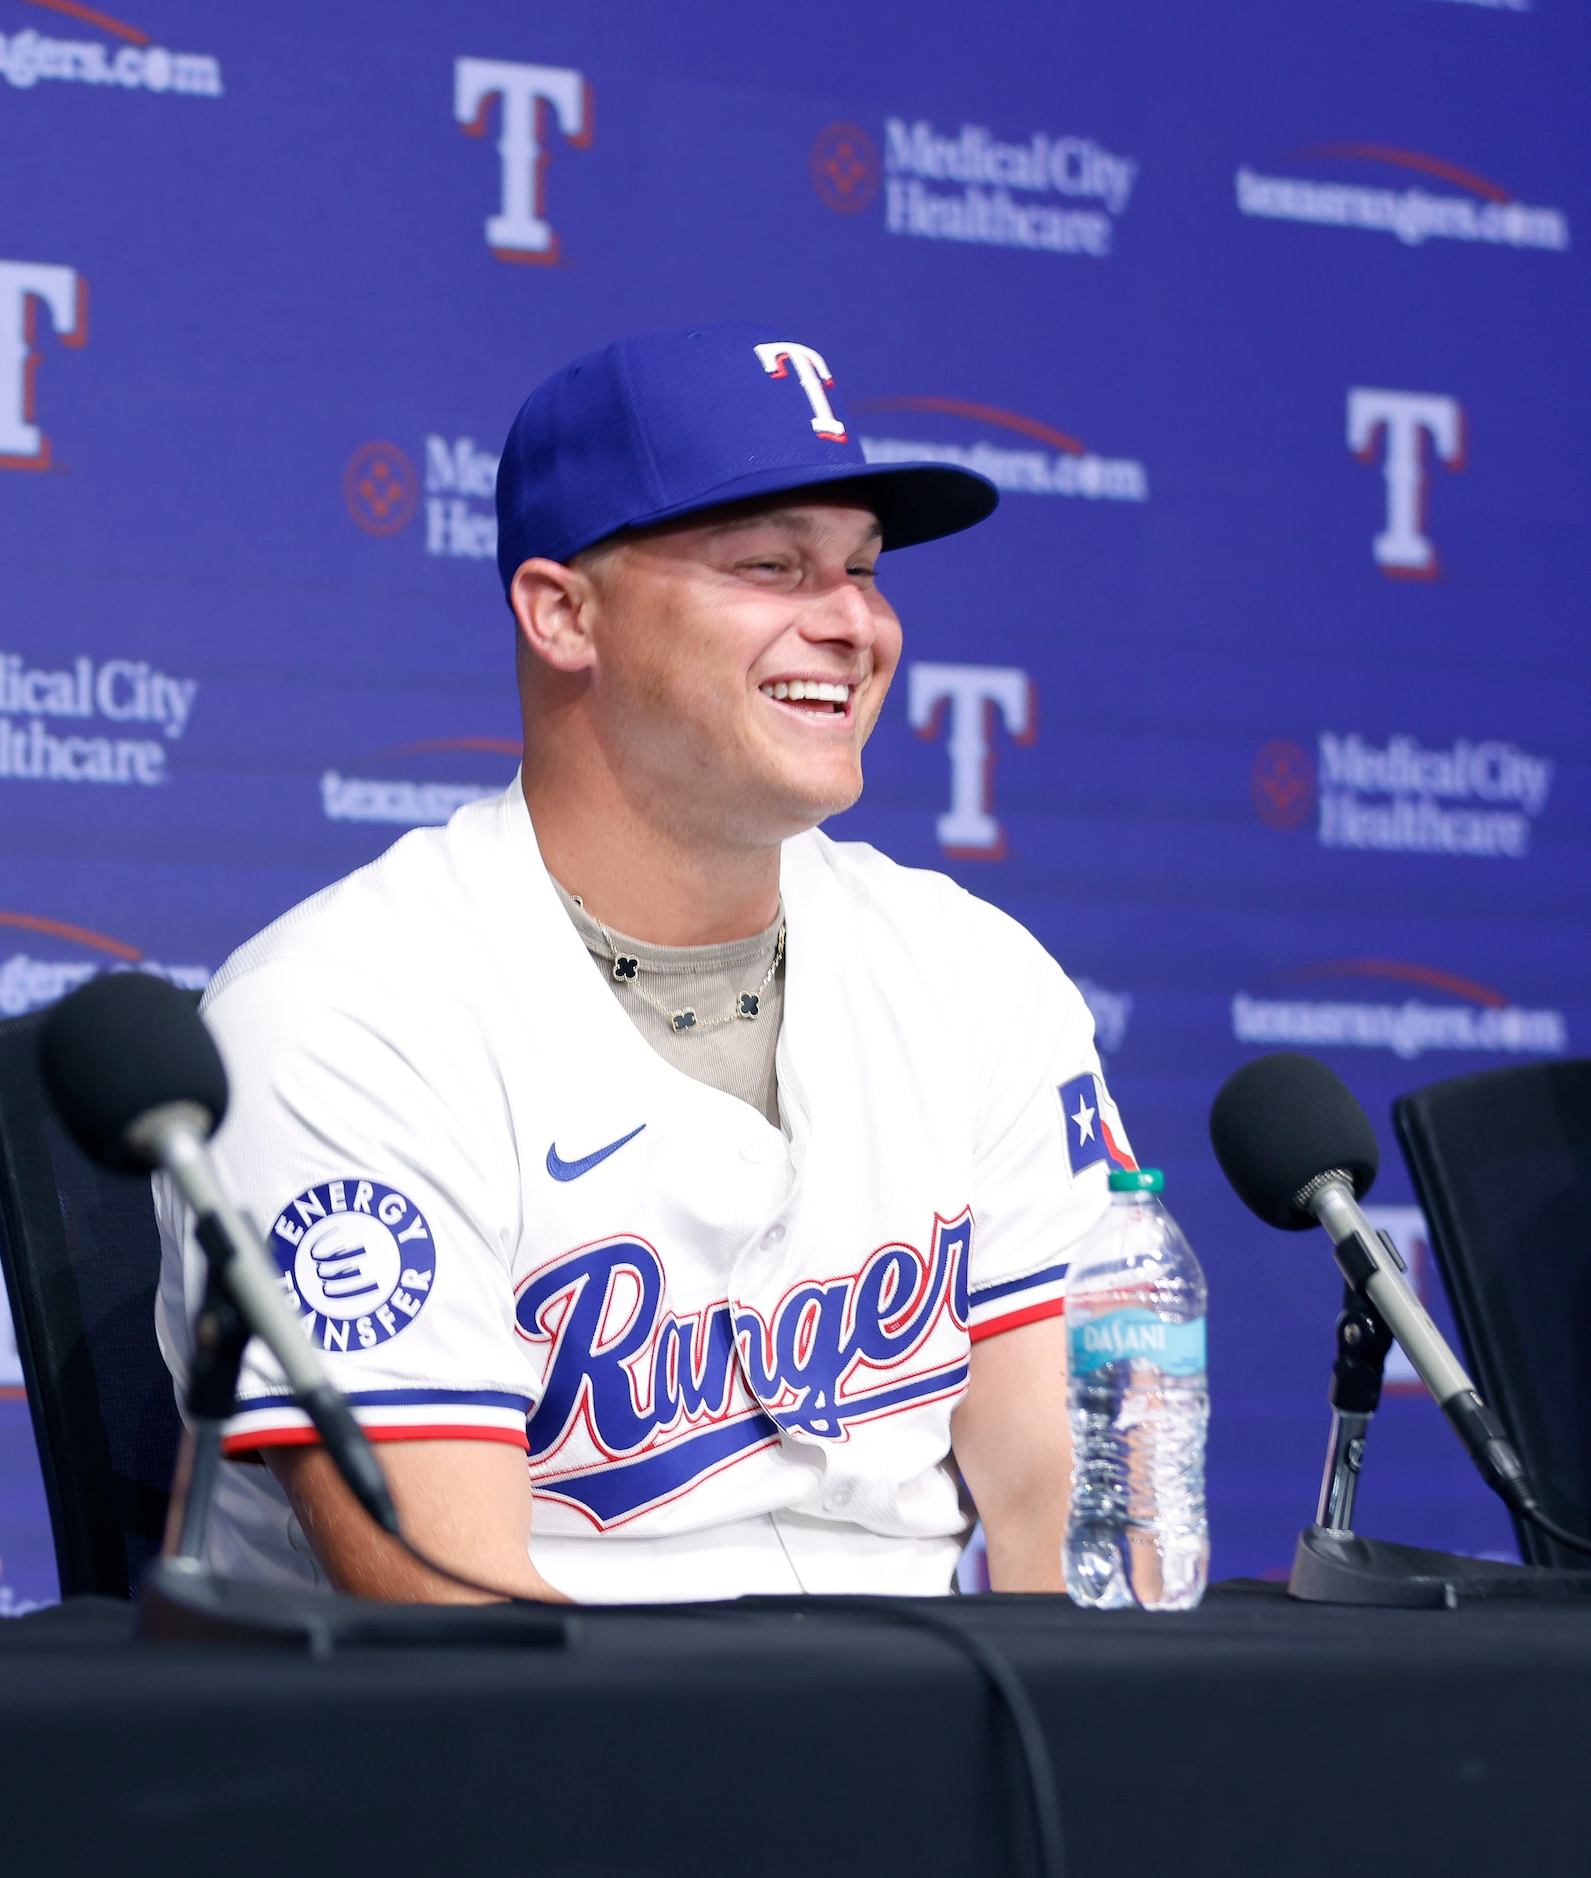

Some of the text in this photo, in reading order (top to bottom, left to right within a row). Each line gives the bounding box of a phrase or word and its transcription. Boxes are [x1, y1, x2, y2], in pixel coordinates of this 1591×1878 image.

[453, 56, 595, 267] T
[753, 341, 848, 444] T
[1346, 386, 1466, 580] T
[95, 658, 200, 741] City
[908, 661, 1040, 860] T
[275, 1180, 429, 1246] ENERGY
[1084, 1318, 1167, 1358] DASANI
